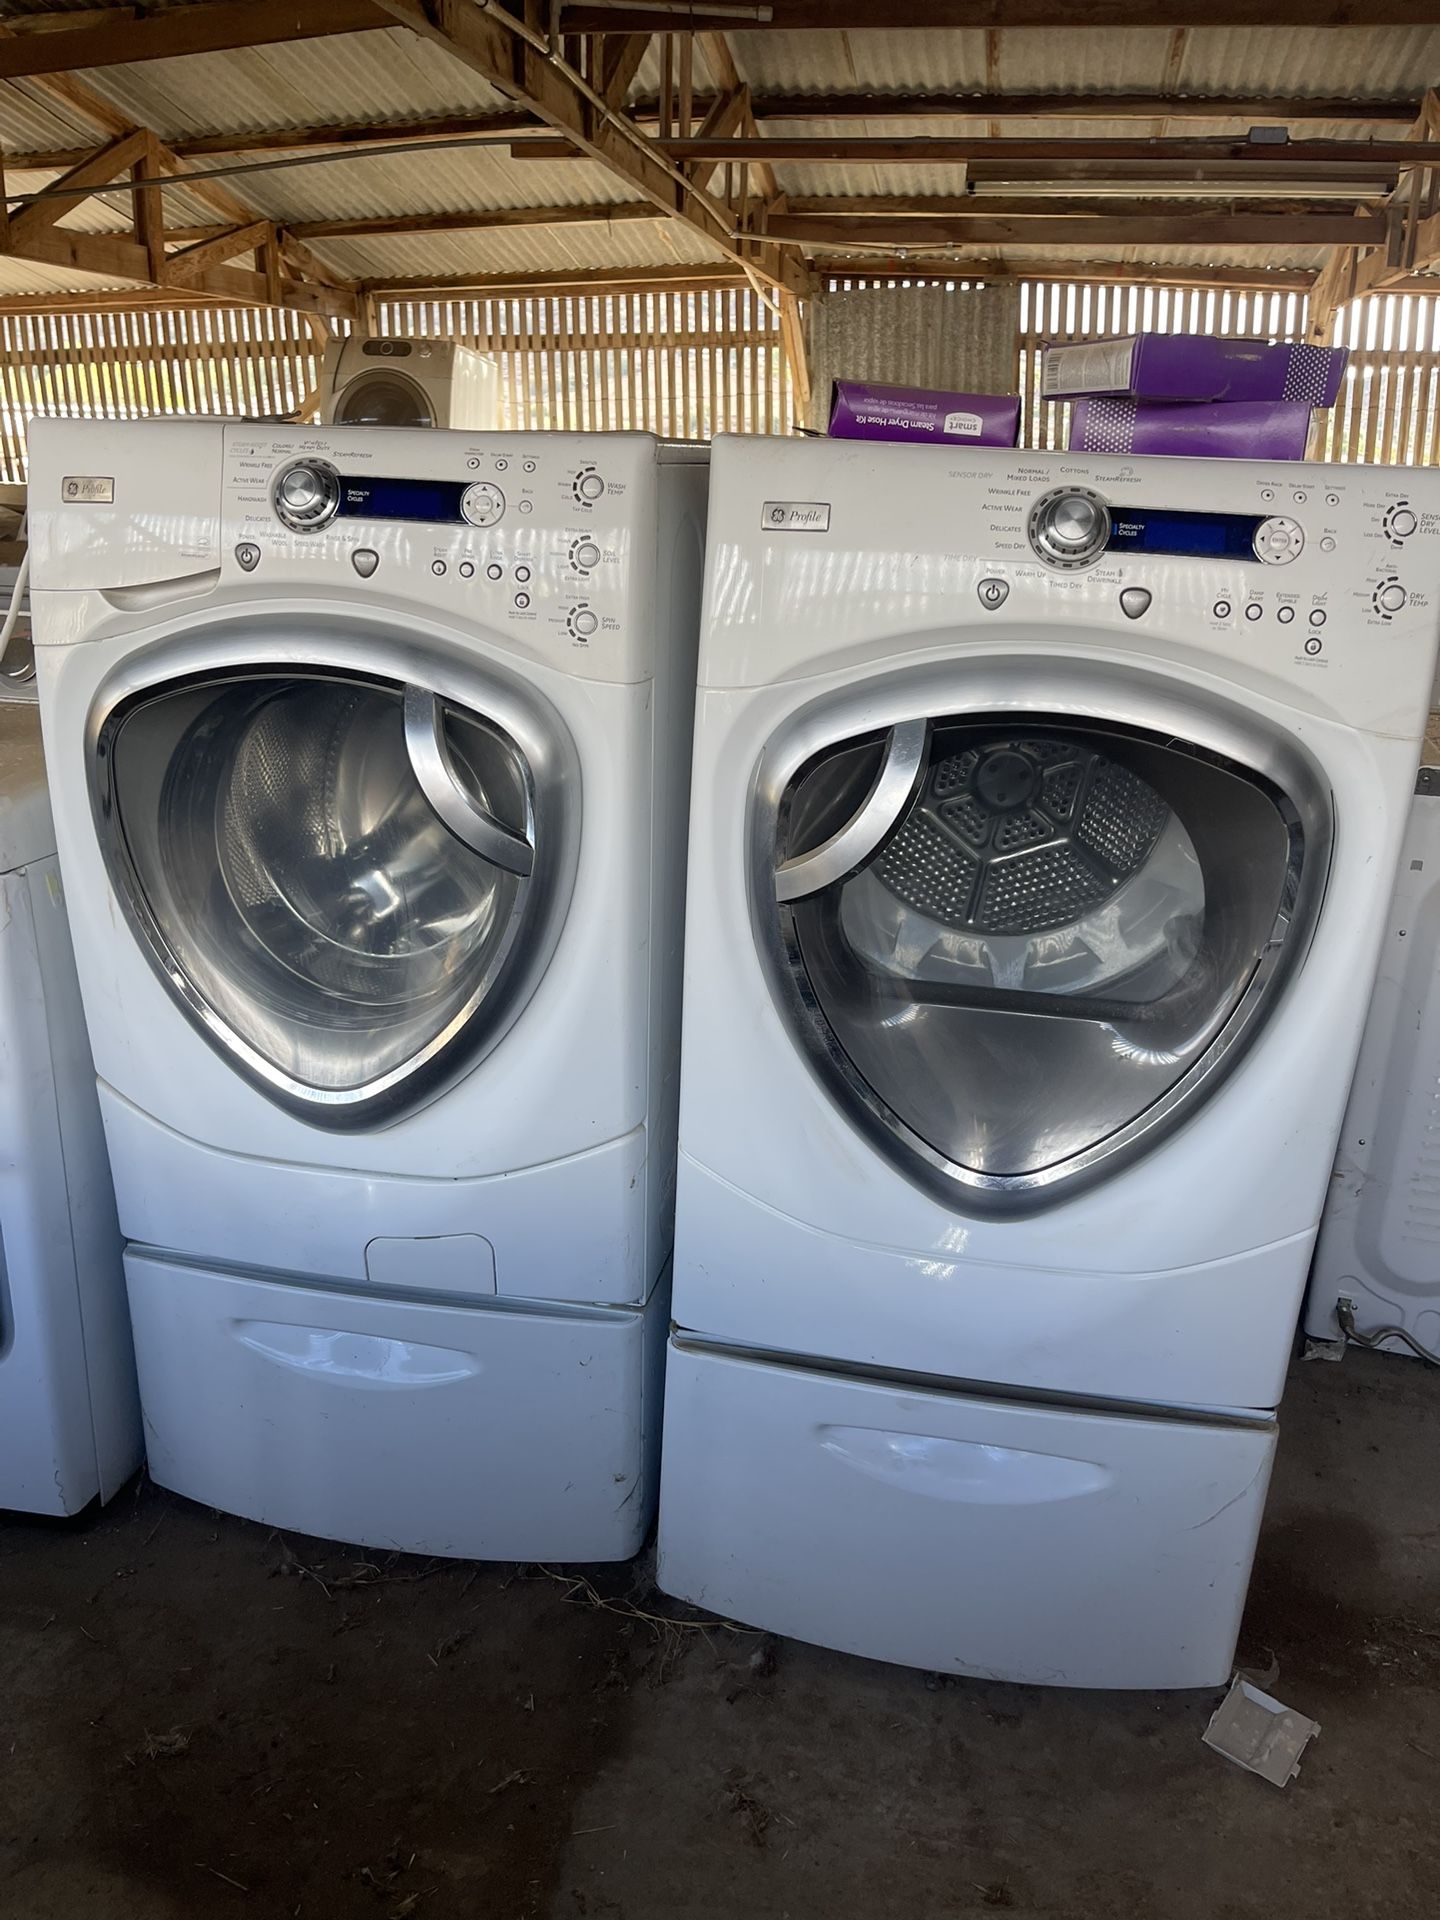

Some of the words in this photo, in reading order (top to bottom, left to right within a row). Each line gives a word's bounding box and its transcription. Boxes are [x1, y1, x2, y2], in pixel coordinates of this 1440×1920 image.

[856, 414, 867, 424] Kit
[868, 415, 887, 426] Hose
[888, 417, 910, 428] Dryer
[910, 420, 935, 432] Steam
[949, 420, 978, 432] smart
[789, 510, 822, 524] Profile
